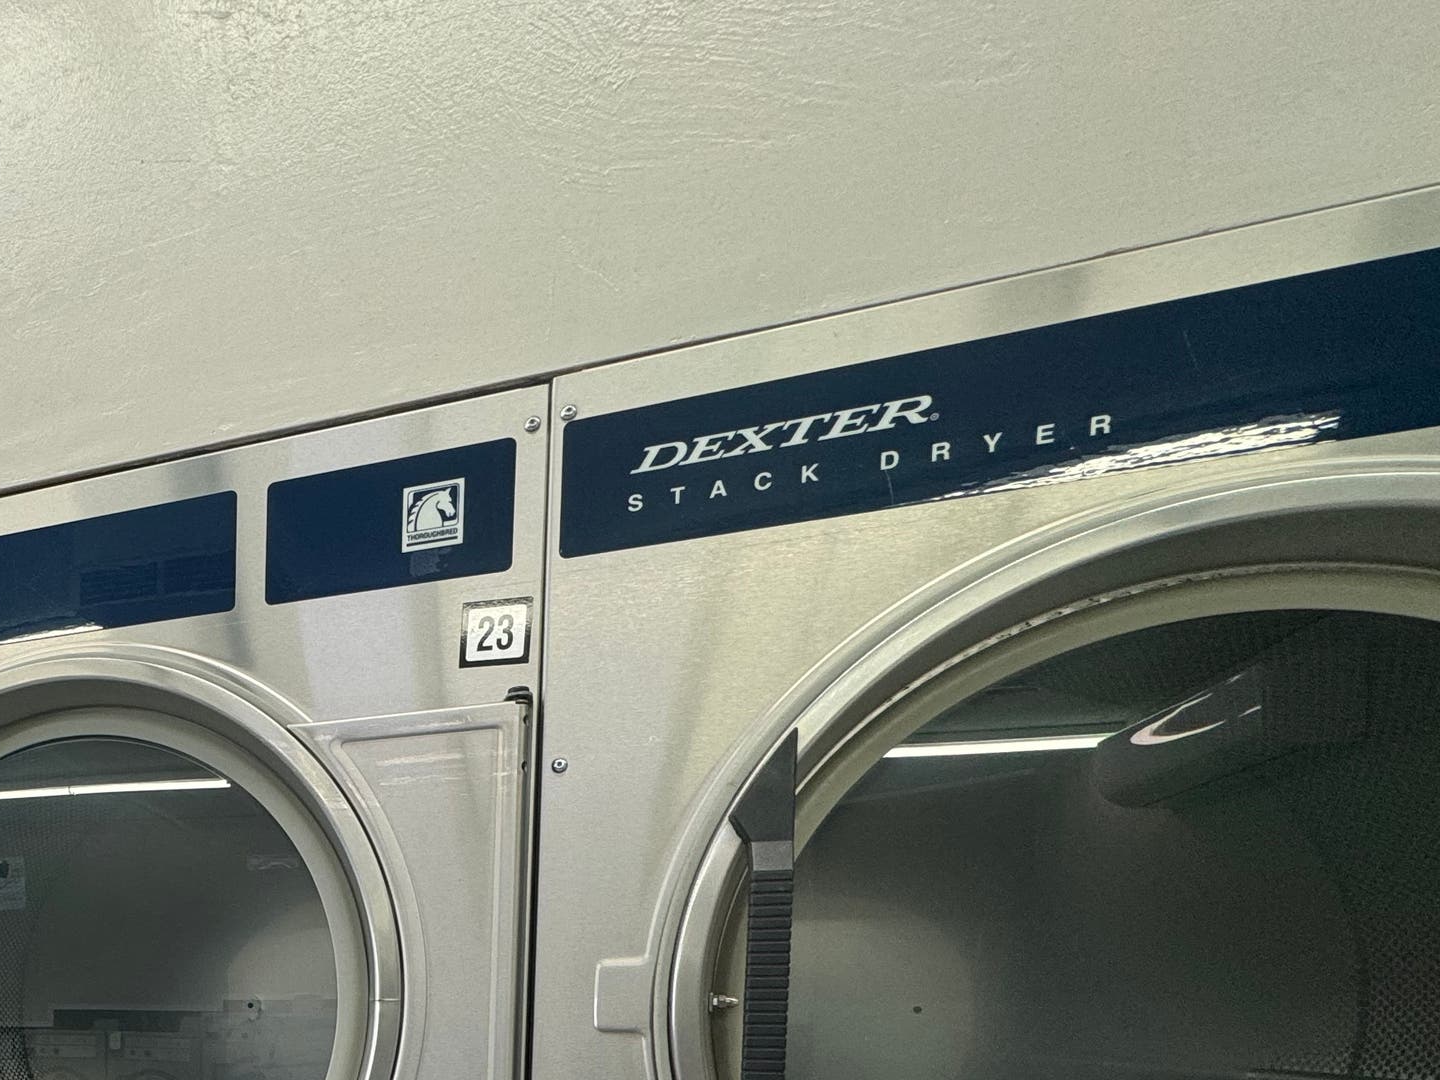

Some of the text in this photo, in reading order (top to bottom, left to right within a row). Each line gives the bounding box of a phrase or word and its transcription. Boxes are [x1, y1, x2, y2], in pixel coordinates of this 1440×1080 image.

[627, 414, 1112, 512] STACK DRYER
[629, 395, 933, 475] DEXTER
[407, 527, 459, 542] THOROUGHBRED
[476, 613, 514, 652] 23
